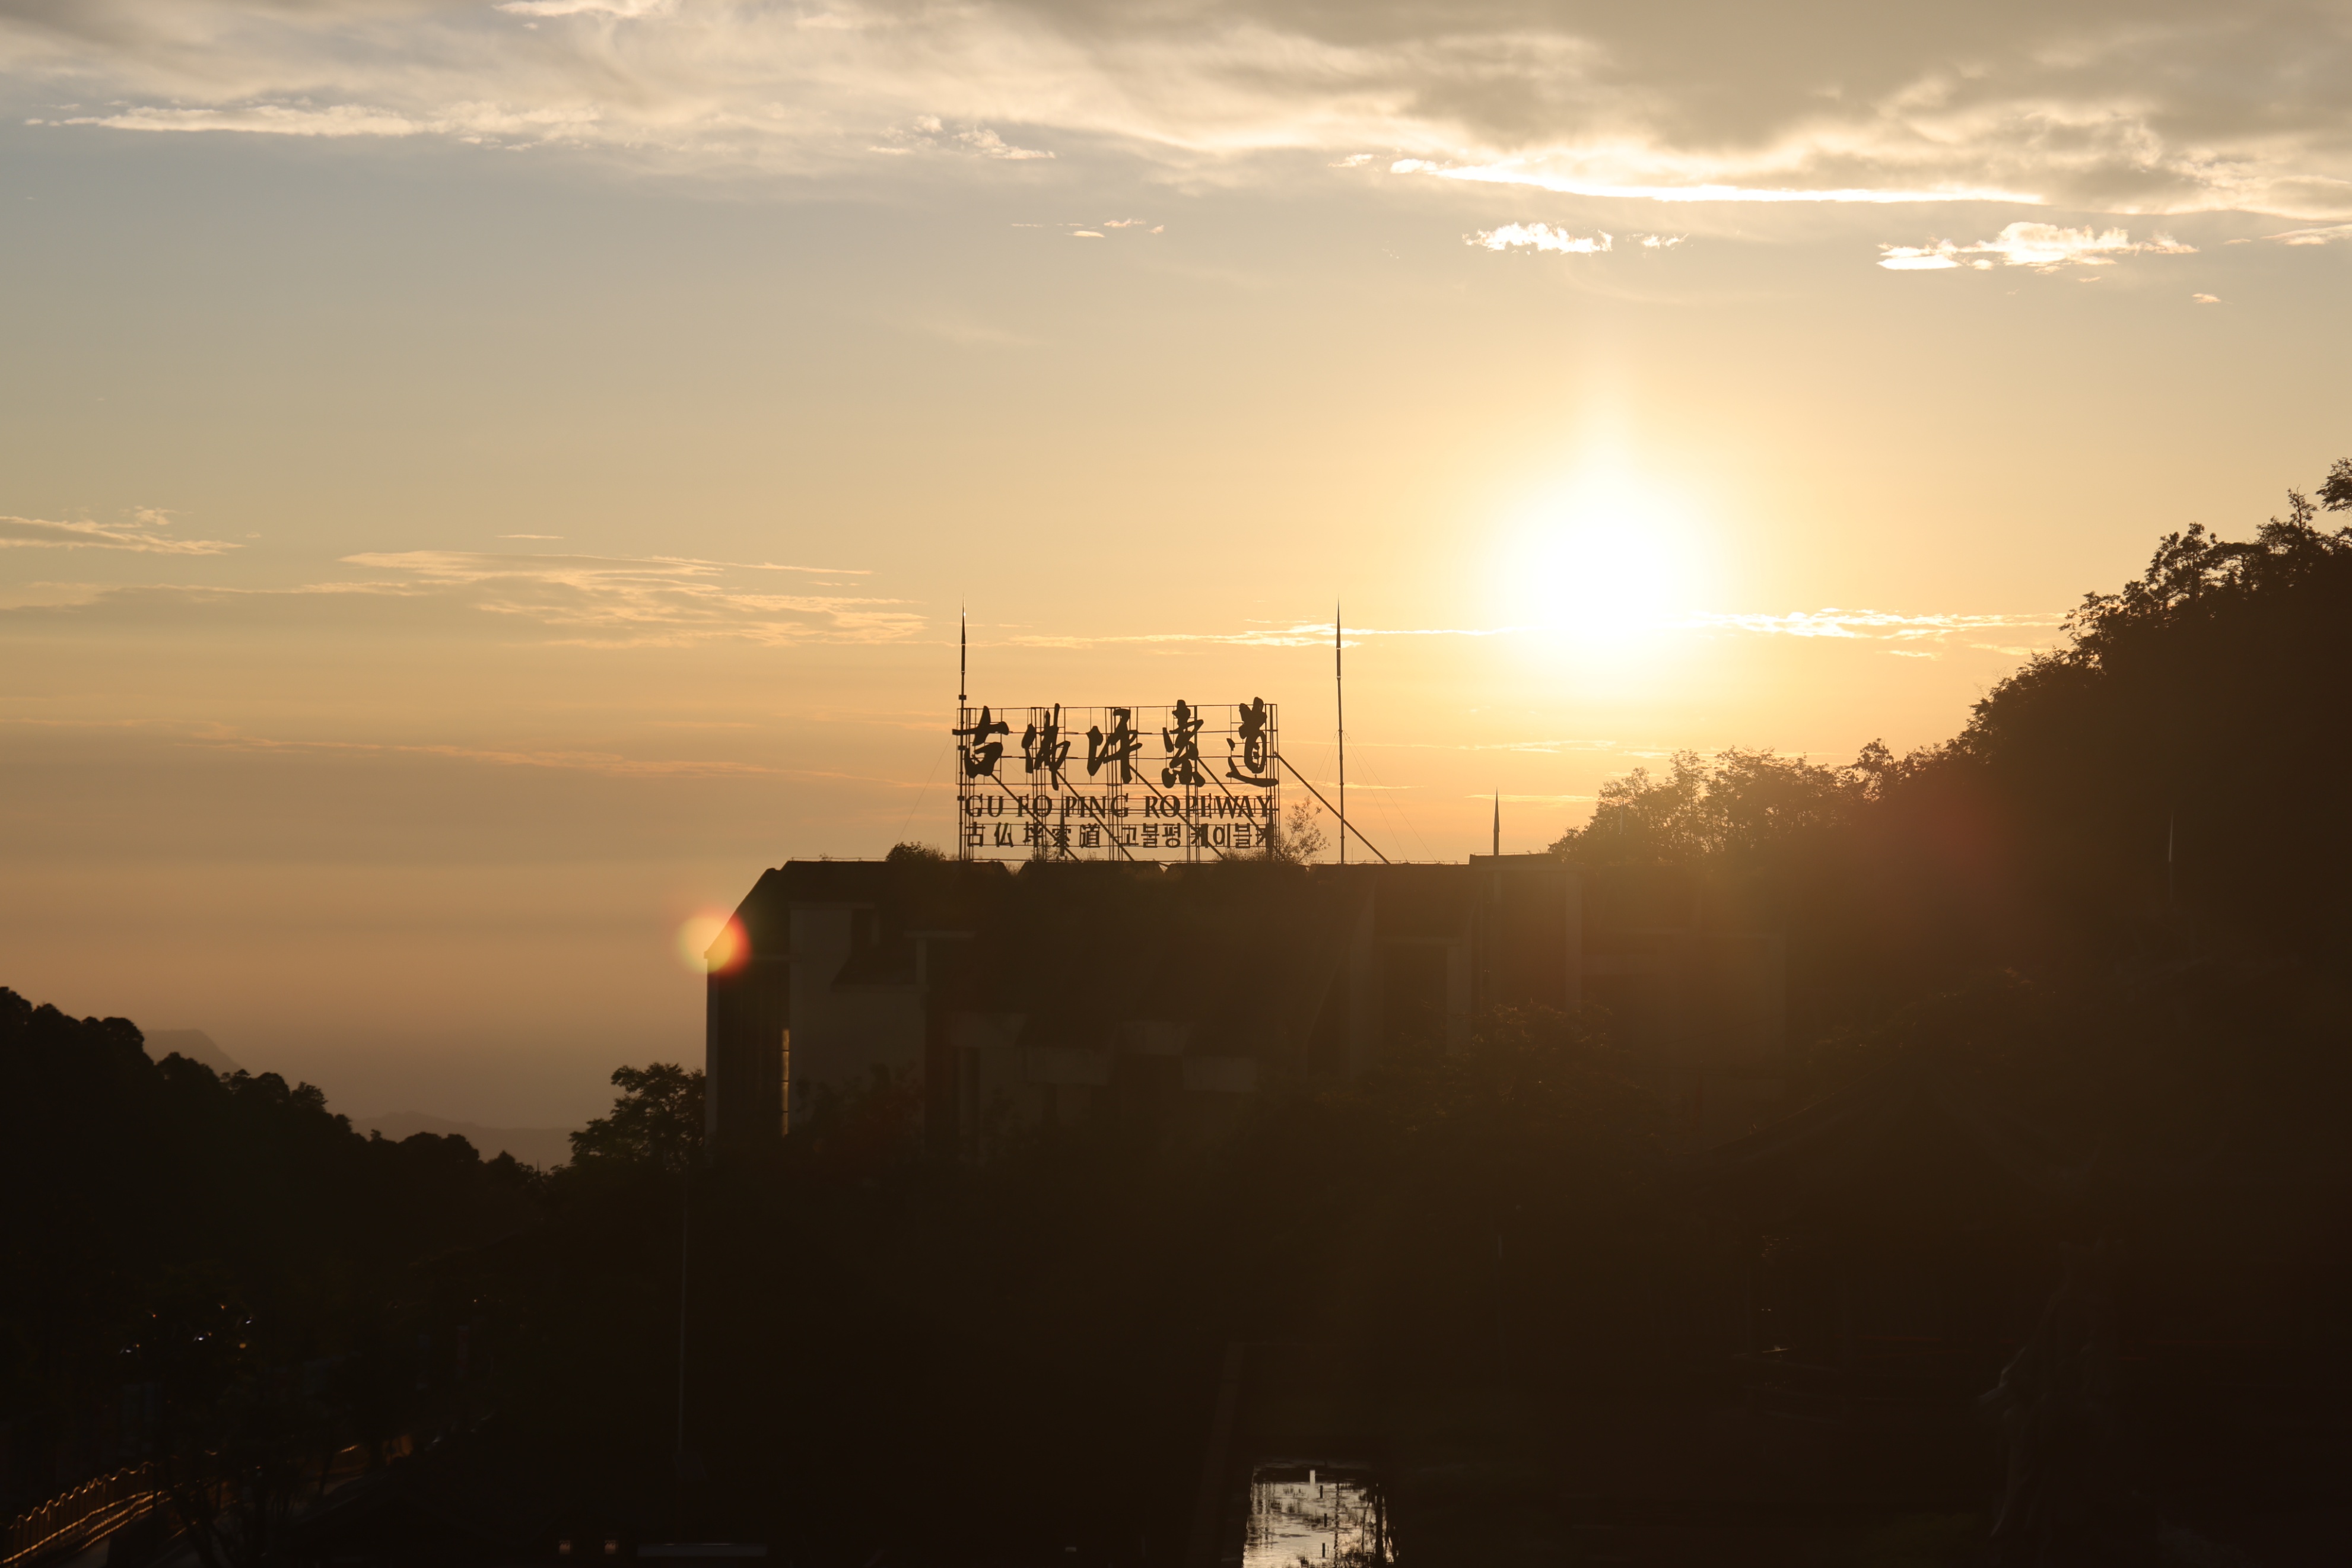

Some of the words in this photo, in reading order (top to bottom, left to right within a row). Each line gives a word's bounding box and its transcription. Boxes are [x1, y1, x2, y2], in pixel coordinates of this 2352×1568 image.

[965, 793, 1004, 818] GU
[1015, 793, 1053, 818] FO
[1063, 793, 1130, 819] PING
[1143, 793, 1273, 819] ROPEWAY
[1118, 822, 1181, 848] 고불평
